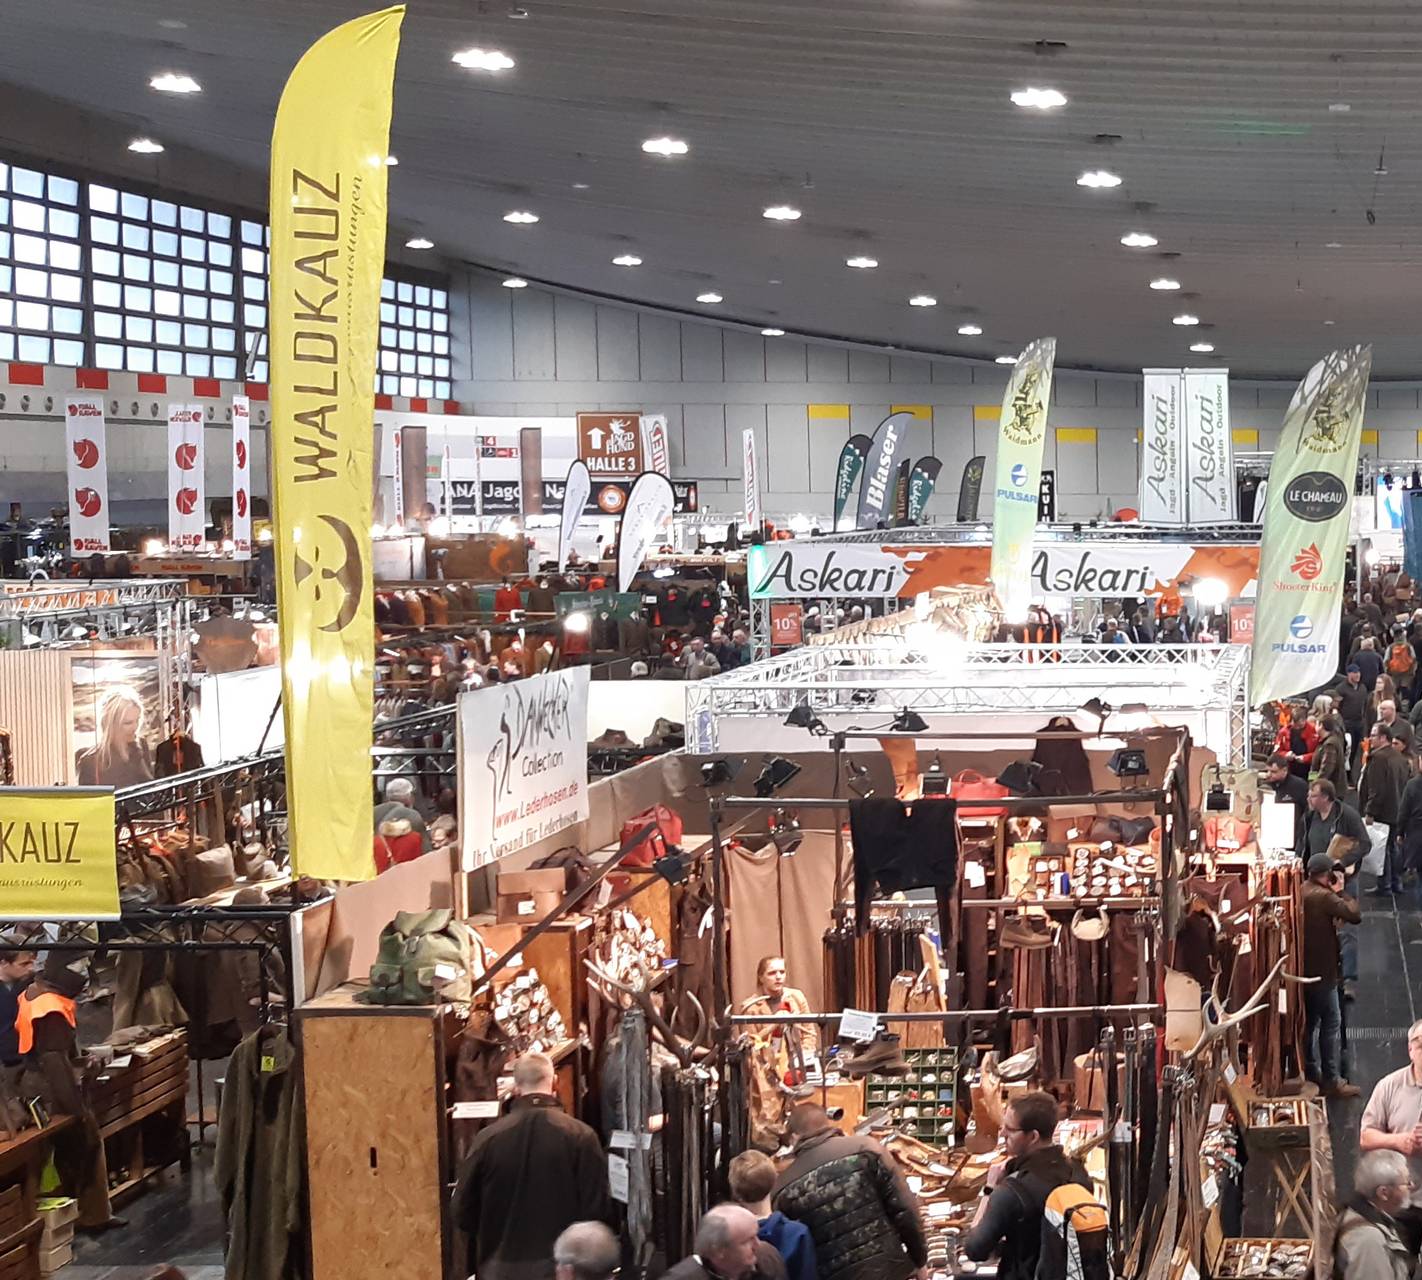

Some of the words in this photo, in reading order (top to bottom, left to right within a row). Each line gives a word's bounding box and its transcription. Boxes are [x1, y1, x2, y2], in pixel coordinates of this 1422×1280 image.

[292, 168, 340, 483] WALDKAUZ
[586, 456, 626, 471] HALLE
[627, 456, 636, 471] 3
[866, 424, 898, 511] Blaser
[1147, 393, 1168, 508] Askari
[1192, 393, 1217, 505] Askari
[996, 488, 1039, 504] PULSAR
[1289, 490, 1301, 502] LE
[1301, 490, 1343, 504] CHAMEAU
[752, 550, 897, 595] Askari
[1031, 550, 1150, 593] Askari
[1271, 643, 1327, 653] PULSAR
[495, 781, 579, 829] www.Lederhosen.de
[0, 821, 82, 863] KAUZ
